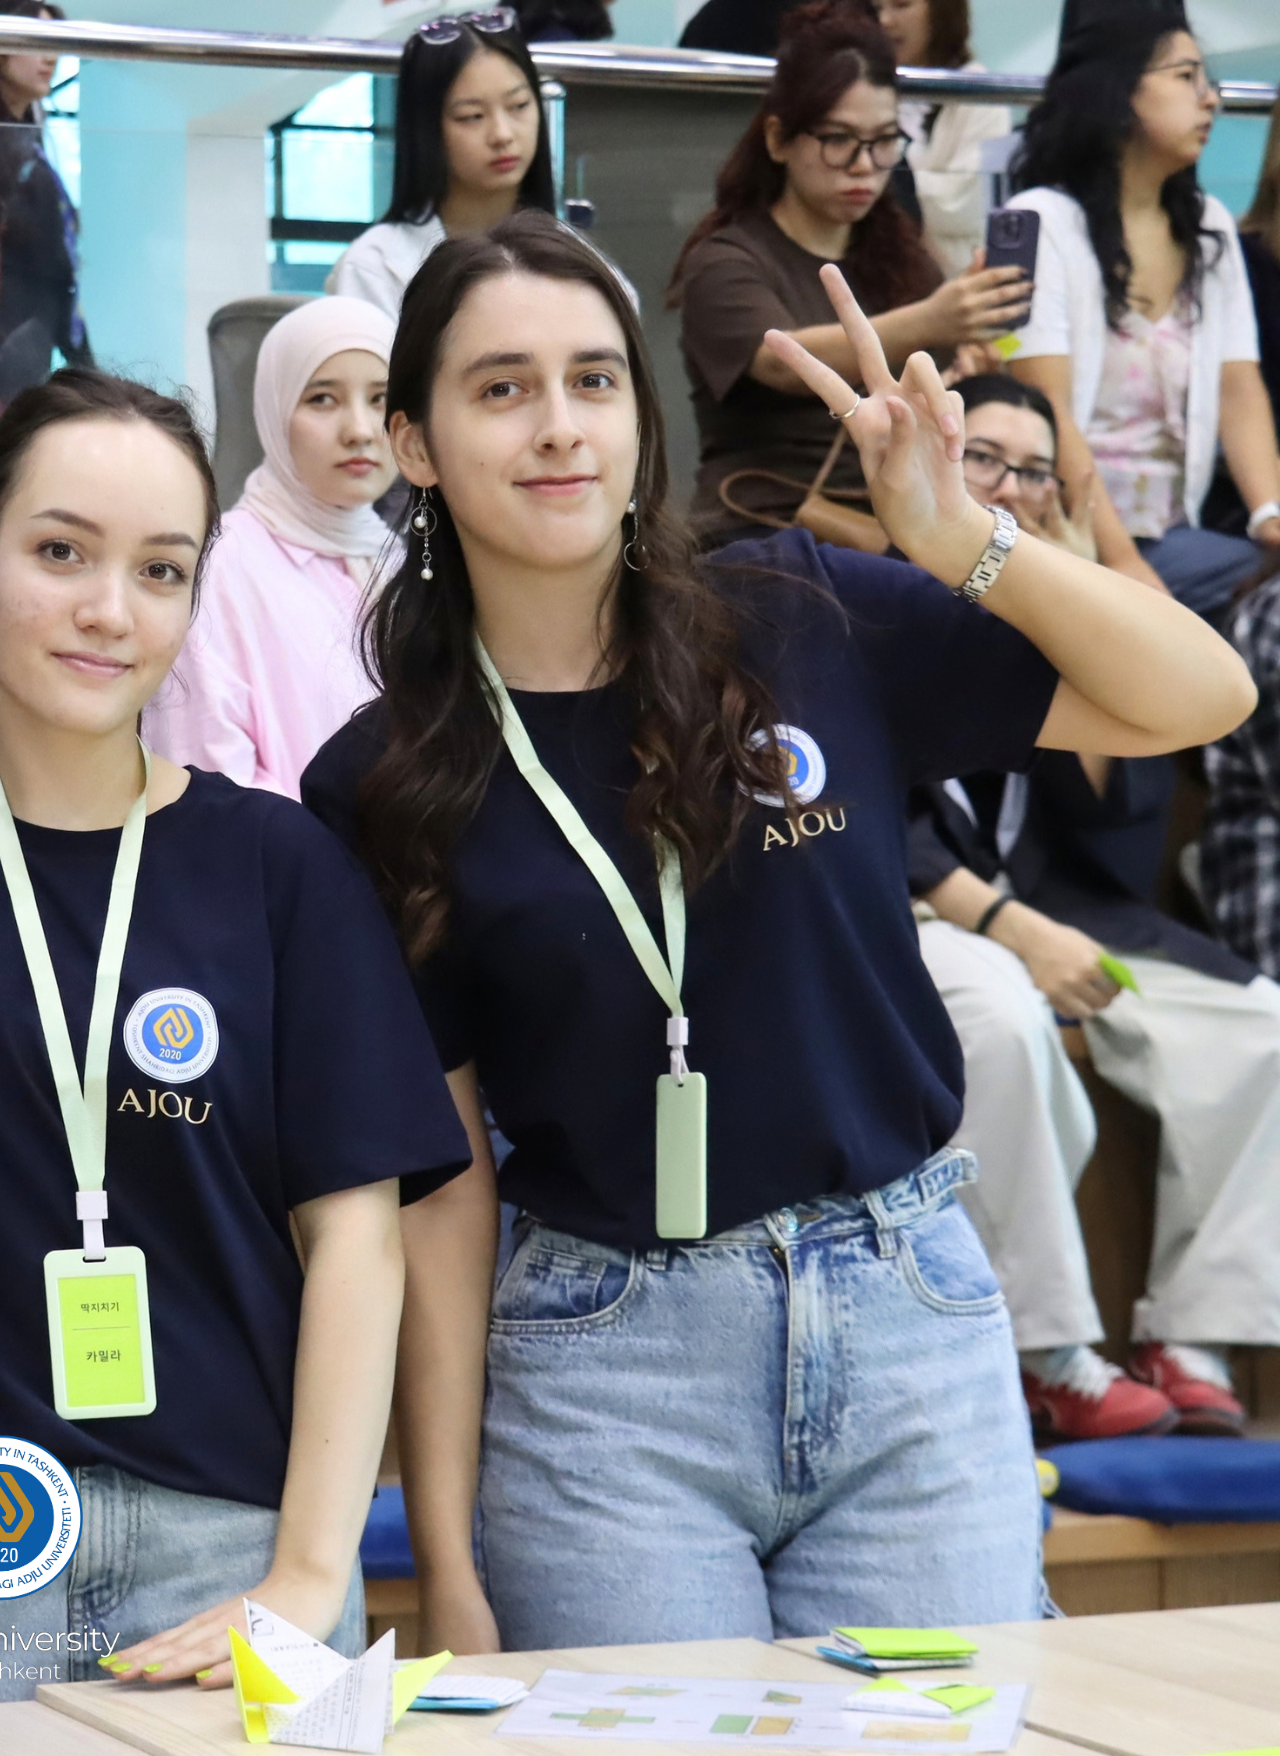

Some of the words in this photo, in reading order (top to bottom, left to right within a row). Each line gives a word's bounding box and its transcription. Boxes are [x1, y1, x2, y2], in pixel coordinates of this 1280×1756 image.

[763, 807, 847, 852] AJOU
[159, 1048, 182, 1061] 2020
[117, 1088, 213, 1125] AJOU
[81, 1302, 120, 1313] 딱지치기
[86, 1349, 121, 1363] 카밀라
